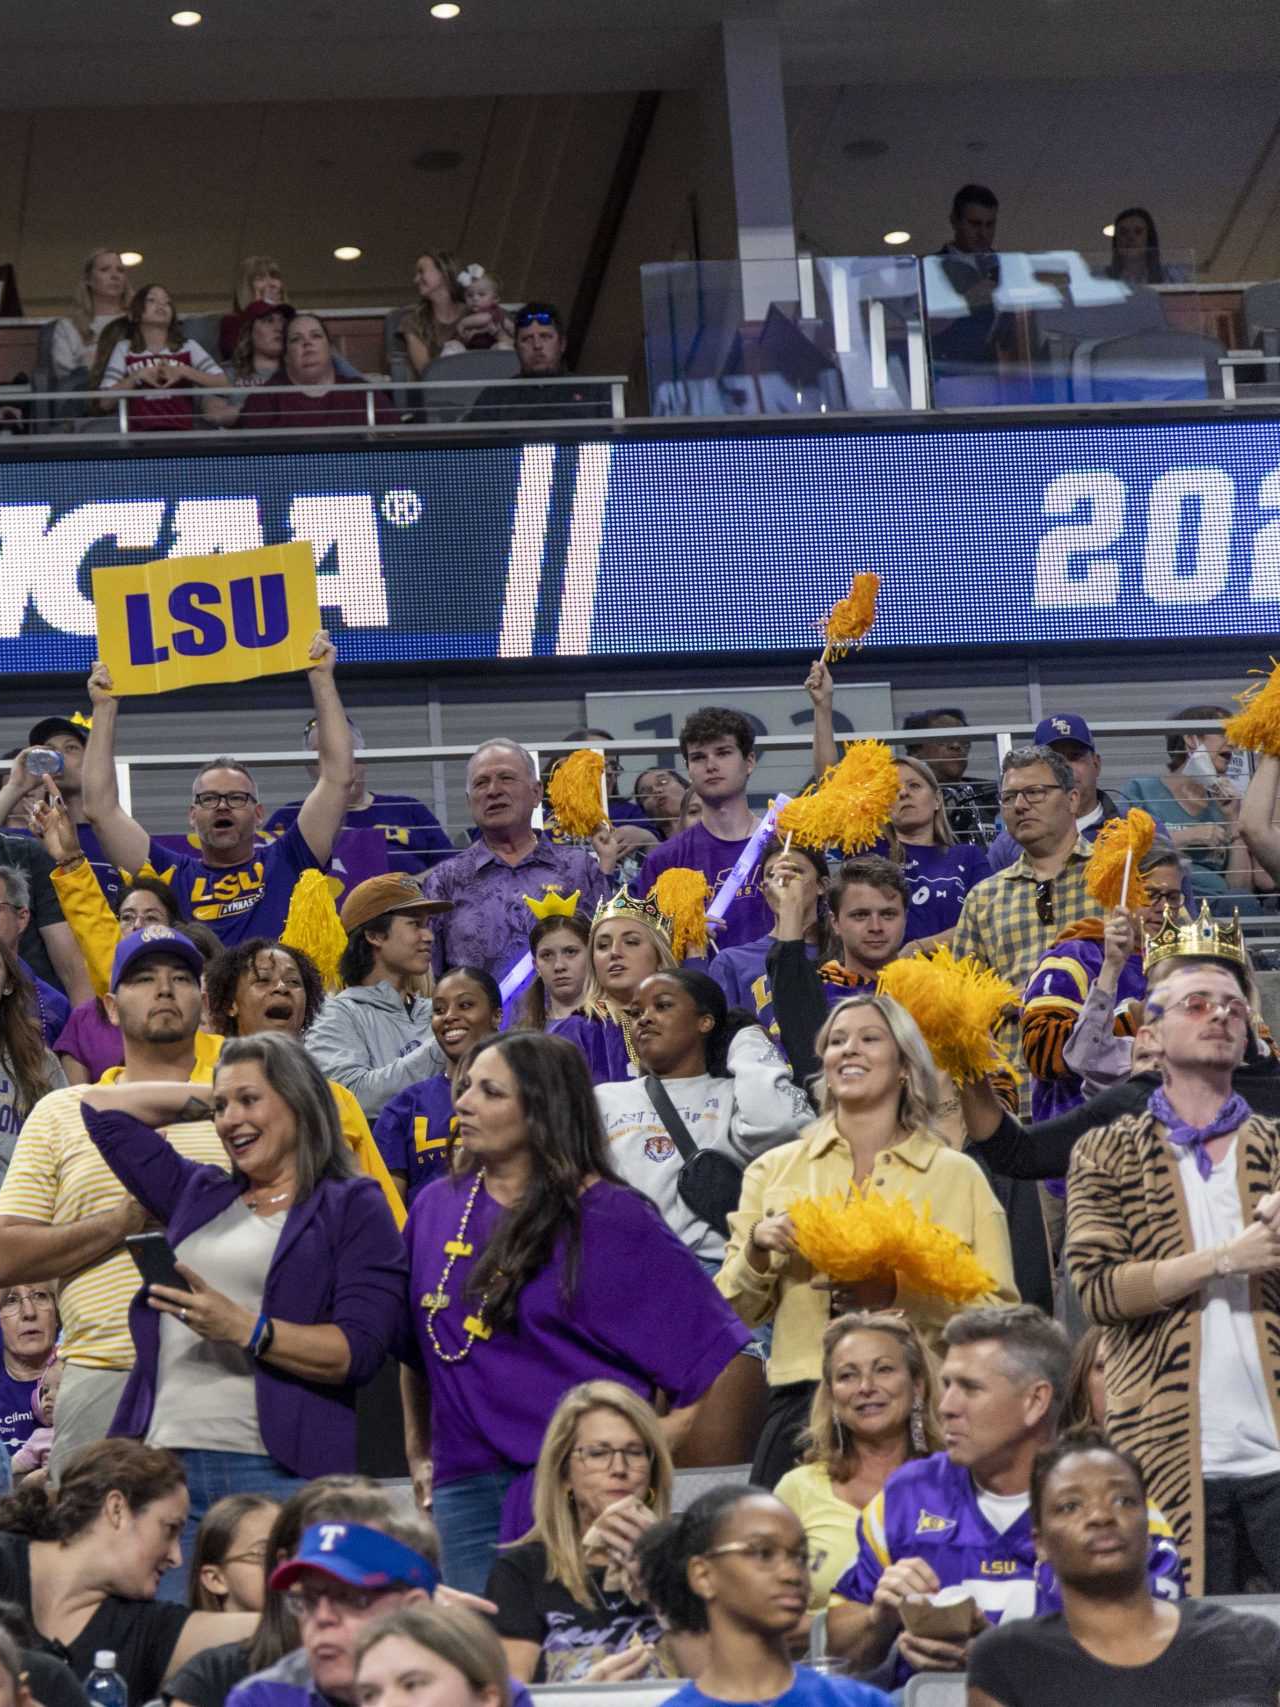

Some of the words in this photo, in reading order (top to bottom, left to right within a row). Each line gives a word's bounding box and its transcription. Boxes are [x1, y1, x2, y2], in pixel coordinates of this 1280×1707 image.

[124, 572, 290, 667] LSU
[1051, 718, 1071, 735] LSU
[191, 862, 265, 902] LSU
[319, 1524, 347, 1552] T
[980, 1560, 1017, 1575] LSU
